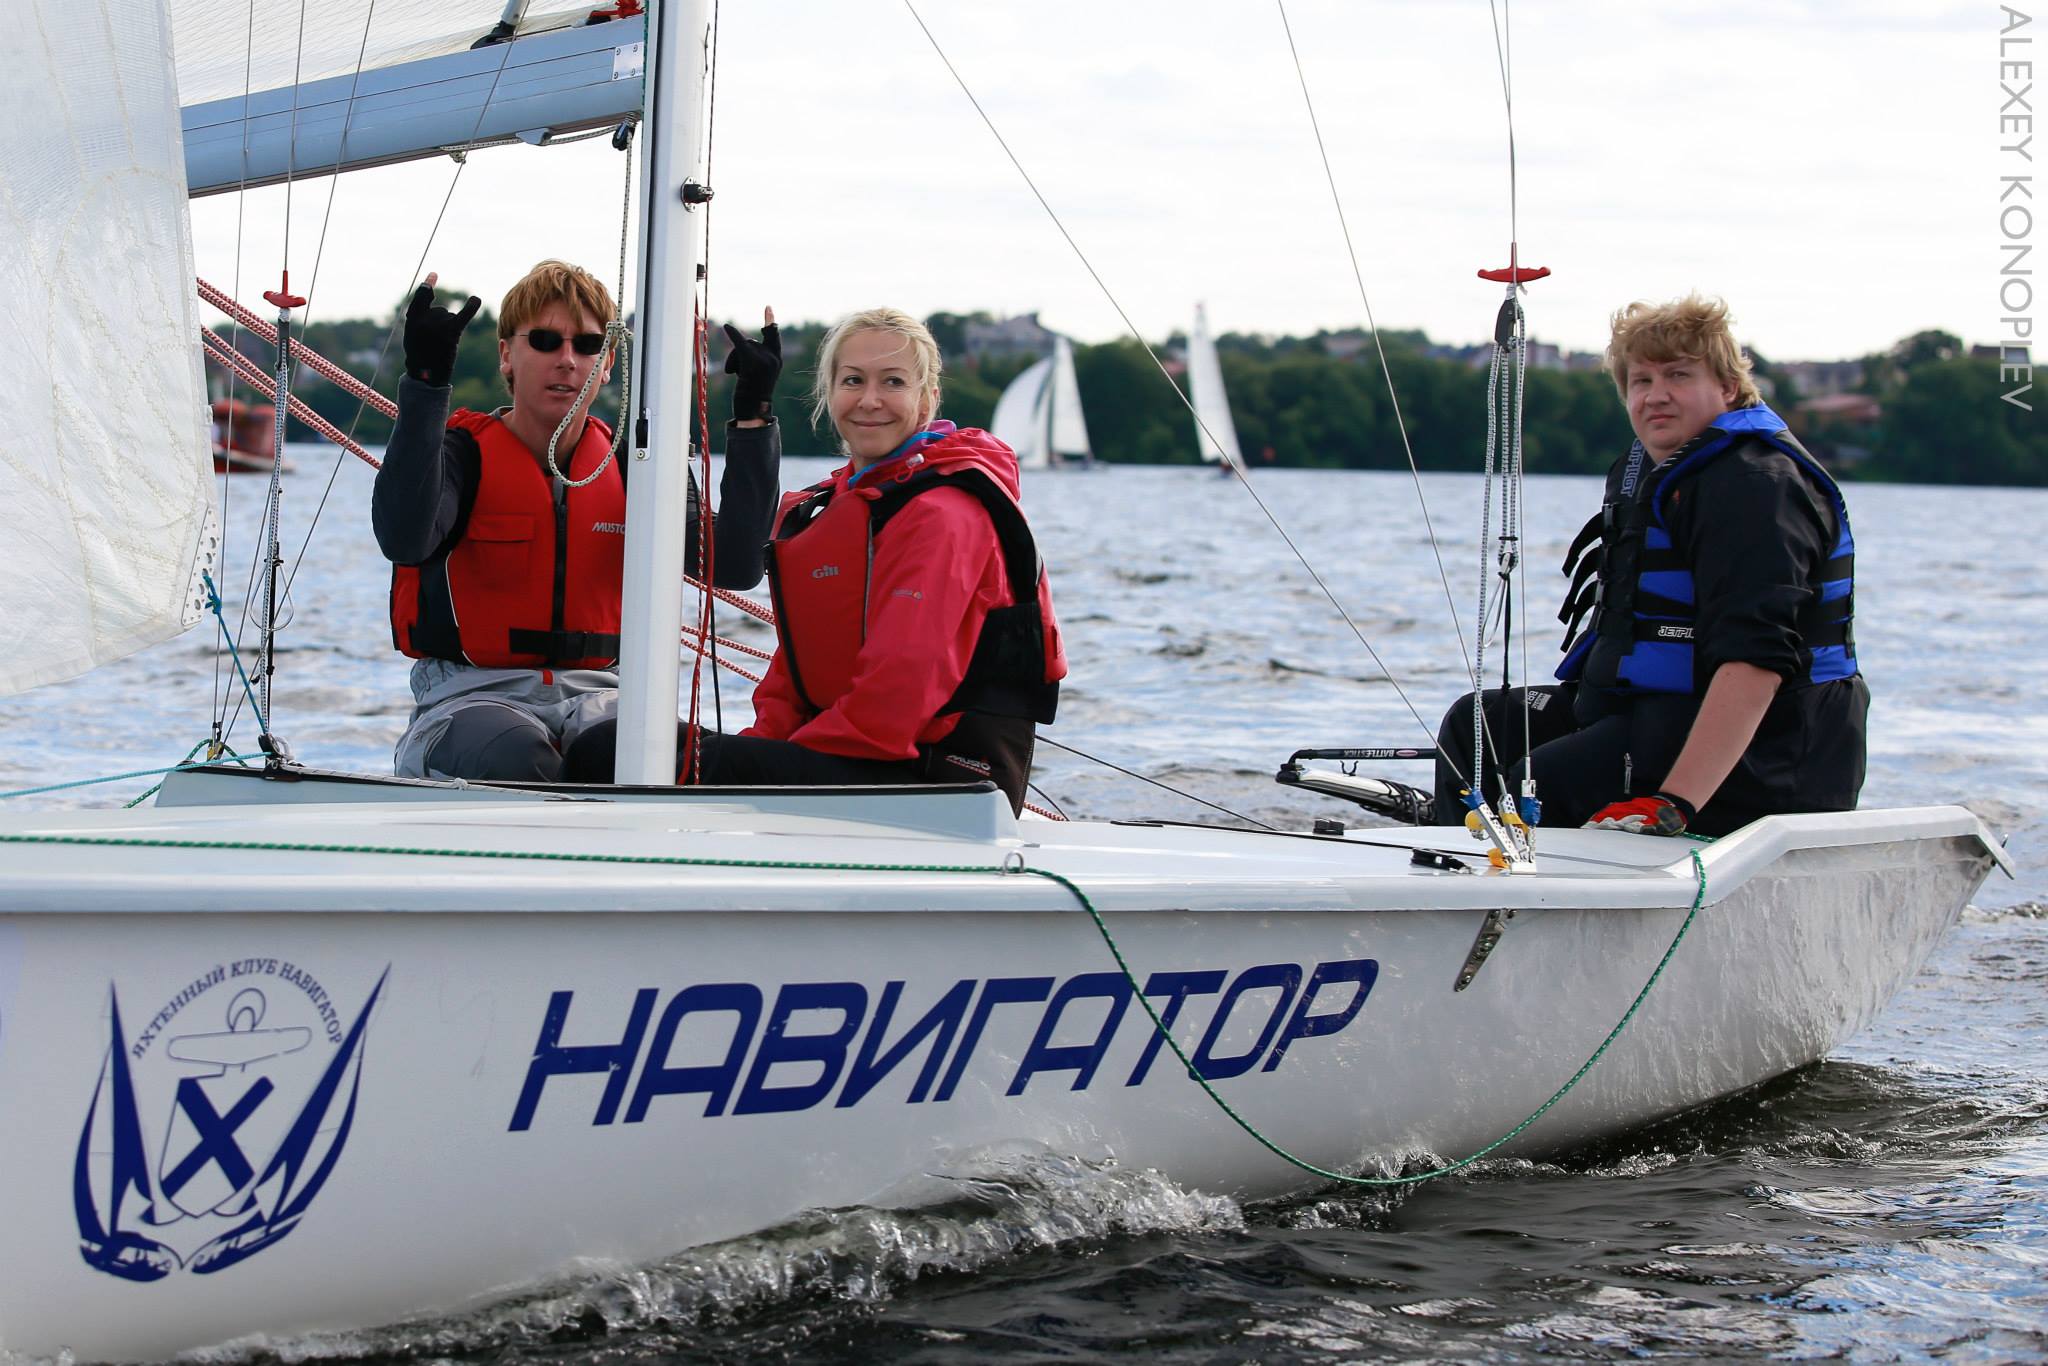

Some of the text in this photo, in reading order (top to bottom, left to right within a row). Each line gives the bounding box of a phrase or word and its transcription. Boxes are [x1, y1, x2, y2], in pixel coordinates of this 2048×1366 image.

[132, 958, 343, 1060] ЯХТЕННЫЙ КЛУБ НАВИГАТОР
[507, 958, 1380, 1132] НАВИГАТОР
